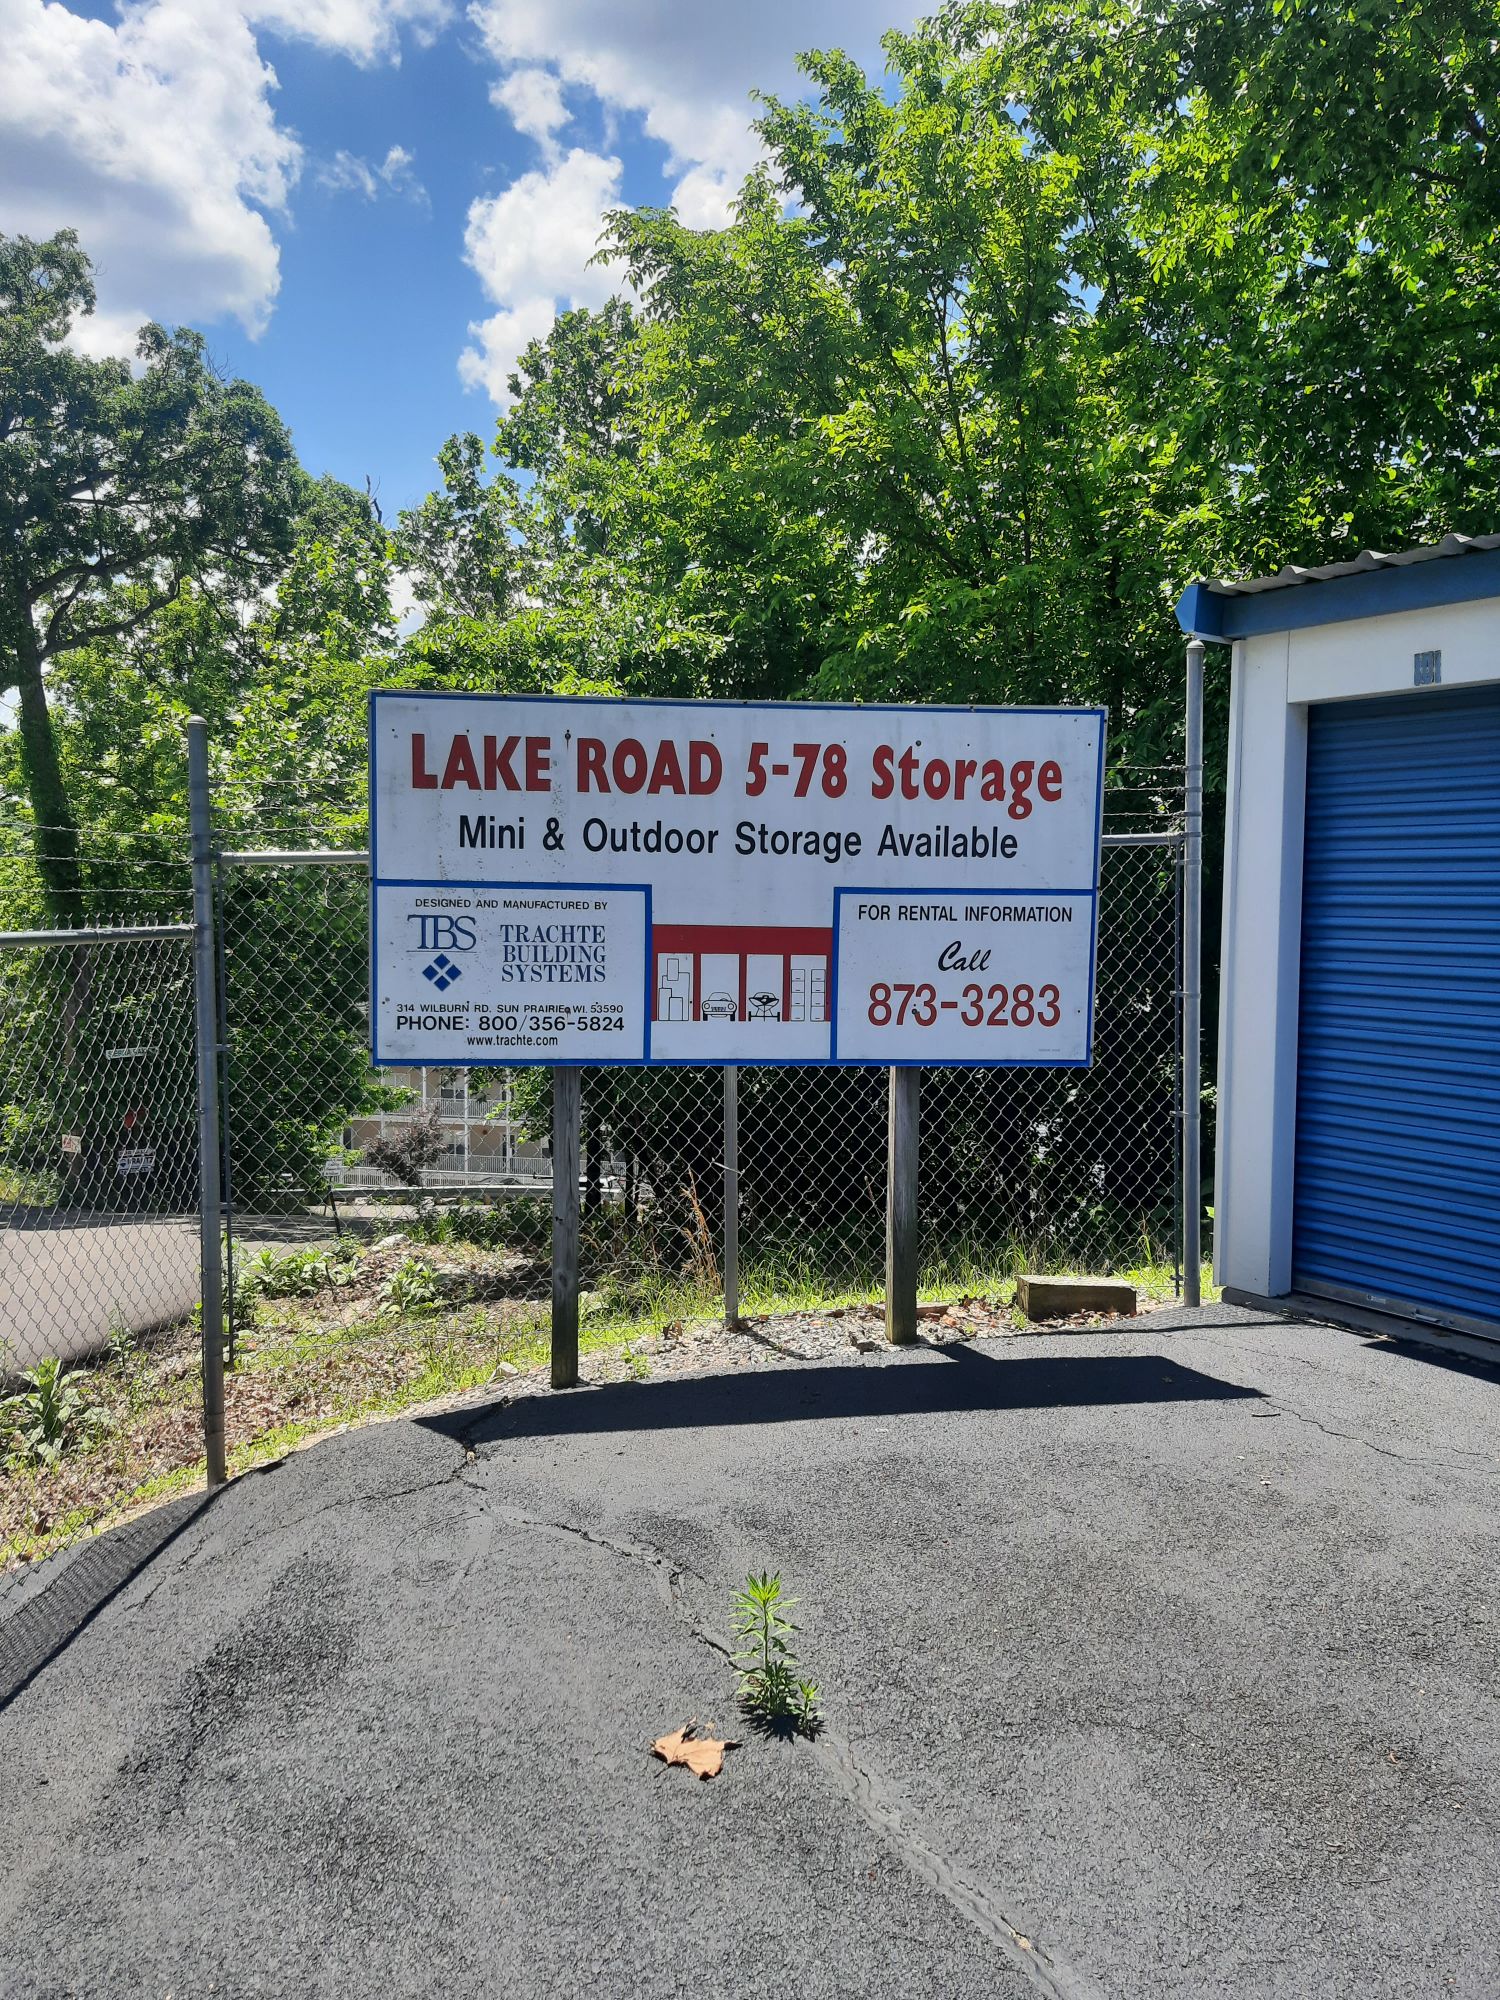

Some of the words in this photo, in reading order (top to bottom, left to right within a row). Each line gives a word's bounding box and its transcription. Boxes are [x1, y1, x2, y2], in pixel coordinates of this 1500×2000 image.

[411, 733, 551, 792] LAKE
[577, 737, 723, 794] ROAD
[745, 742, 848, 798] 5-78
[871, 744, 1063, 820] Storage
[459, 814, 525, 849] Mini
[542, 817, 565, 851] &
[582, 817, 719, 854] Outdoor
[734, 821, 862, 863] Storage
[877, 824, 1019, 859] Available
[415, 898, 471, 908] DESIGNED
[475, 899, 499, 909] AND
[503, 900, 590, 910] MANUFACTURED
[594, 901, 608, 910] BY
[858, 904, 891, 921] FOR
[898, 905, 958, 922] RENTAL
[964, 905, 1073, 923] INFORMATION
[407, 914, 477, 950] TBS
[500, 924, 606, 944] TRACHTE
[502, 944, 606, 963] BUILDING
[937, 940, 992, 972] Call
[501, 964, 606, 983] SYSTEMS
[396, 1003, 415, 1013] 314
[420, 1004, 470, 1013] WILBURN
[474, 1005, 492, 1013] RD.
[496, 1005, 519, 1014] SUN
[572, 1004, 588, 1014] WI.
[590, 1004, 624, 1014] 53590
[867, 982, 1061, 1028] 873-3283
[396, 1015, 470, 1031] PHONE:
[478, 1015, 625, 1032] 800/356-5824
[466, 1034, 558, 1046] www.trachte.com
